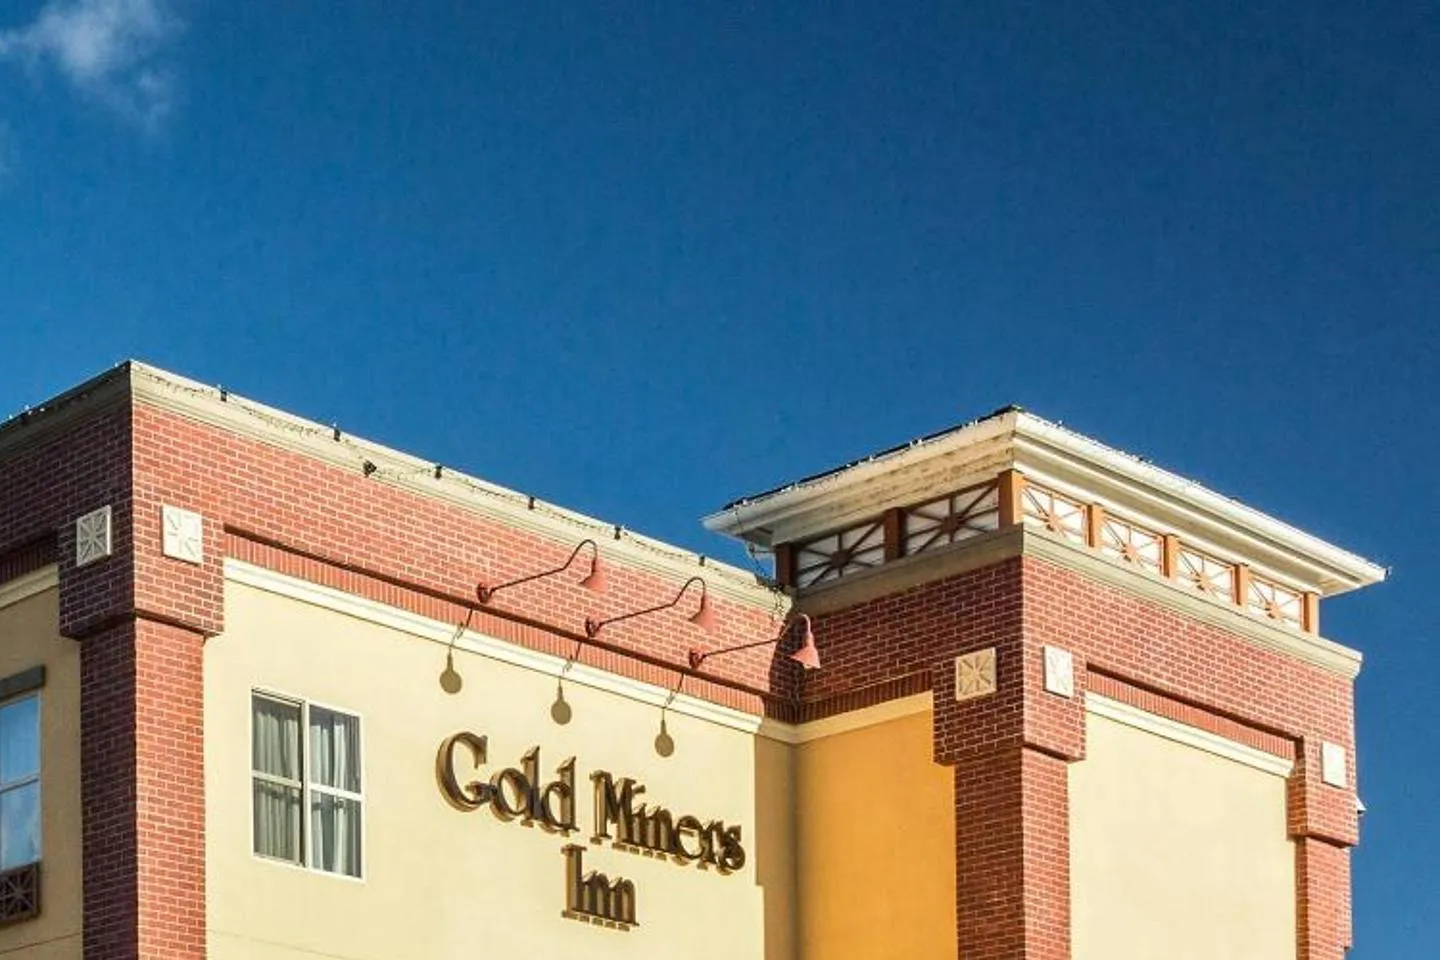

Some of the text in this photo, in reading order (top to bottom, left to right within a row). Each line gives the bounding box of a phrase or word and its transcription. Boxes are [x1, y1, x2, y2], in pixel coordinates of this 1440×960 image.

[436, 731, 747, 875] Gold Miners
[561, 843, 640, 931] Inn
